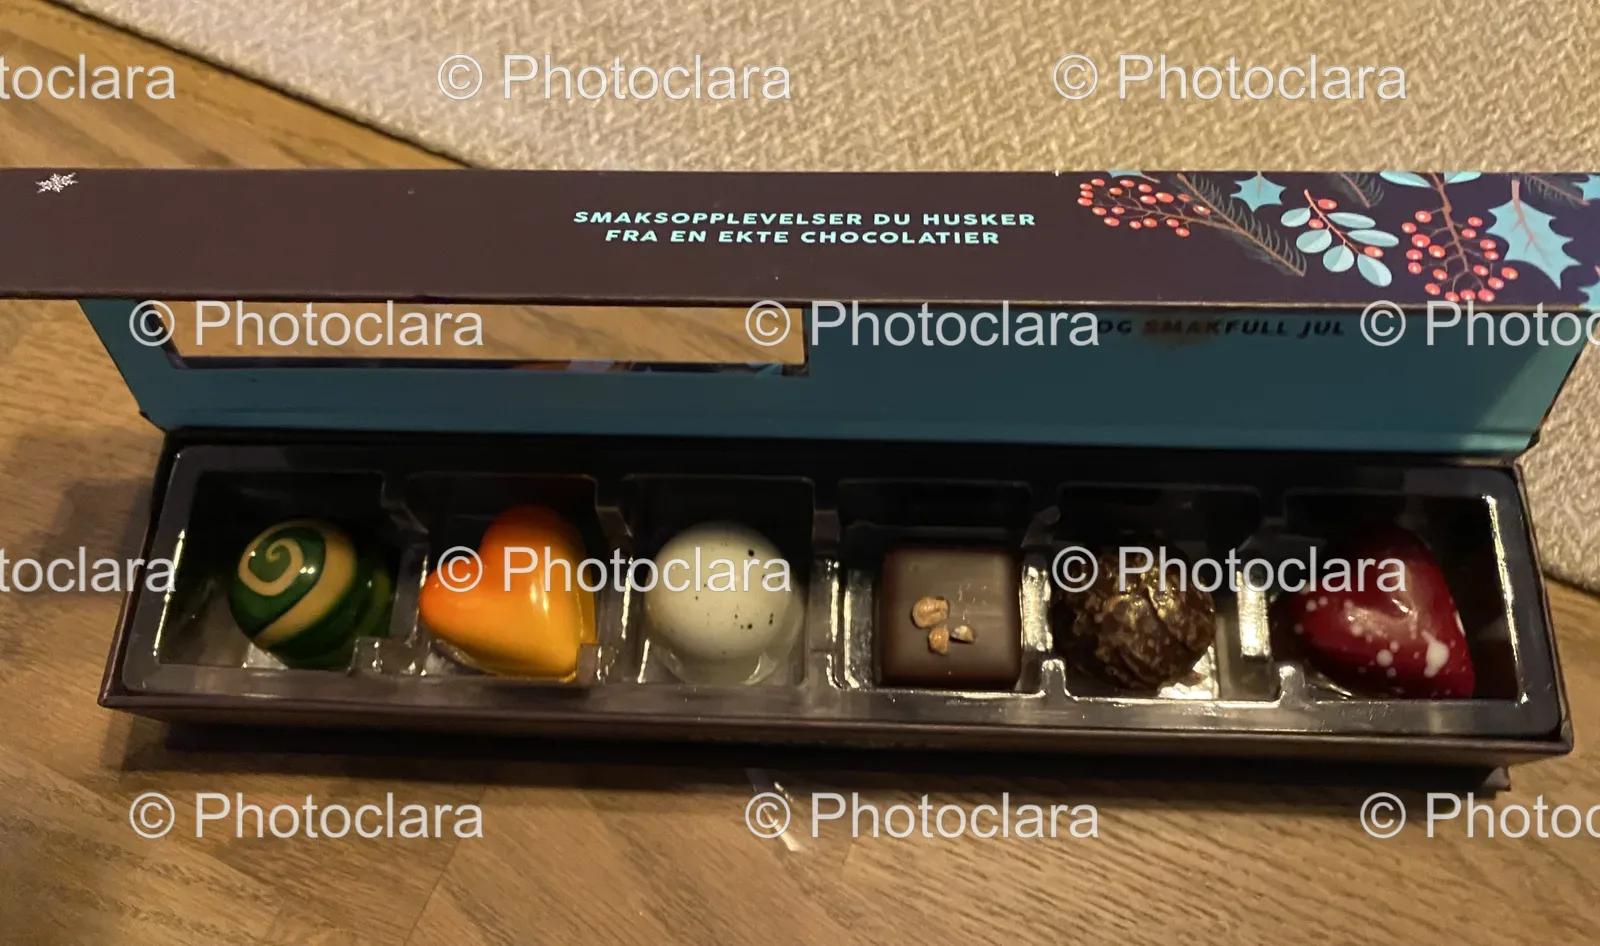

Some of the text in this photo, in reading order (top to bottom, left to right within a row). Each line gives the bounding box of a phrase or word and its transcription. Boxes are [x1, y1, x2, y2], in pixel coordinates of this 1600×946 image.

[573, 211, 1036, 226] SMAKSOPPLEVELSER DU HUSKER
[605, 229, 999, 245] FRA EN EKTE CHOCOLATIER
[1297, 320, 1345, 339] JUL
